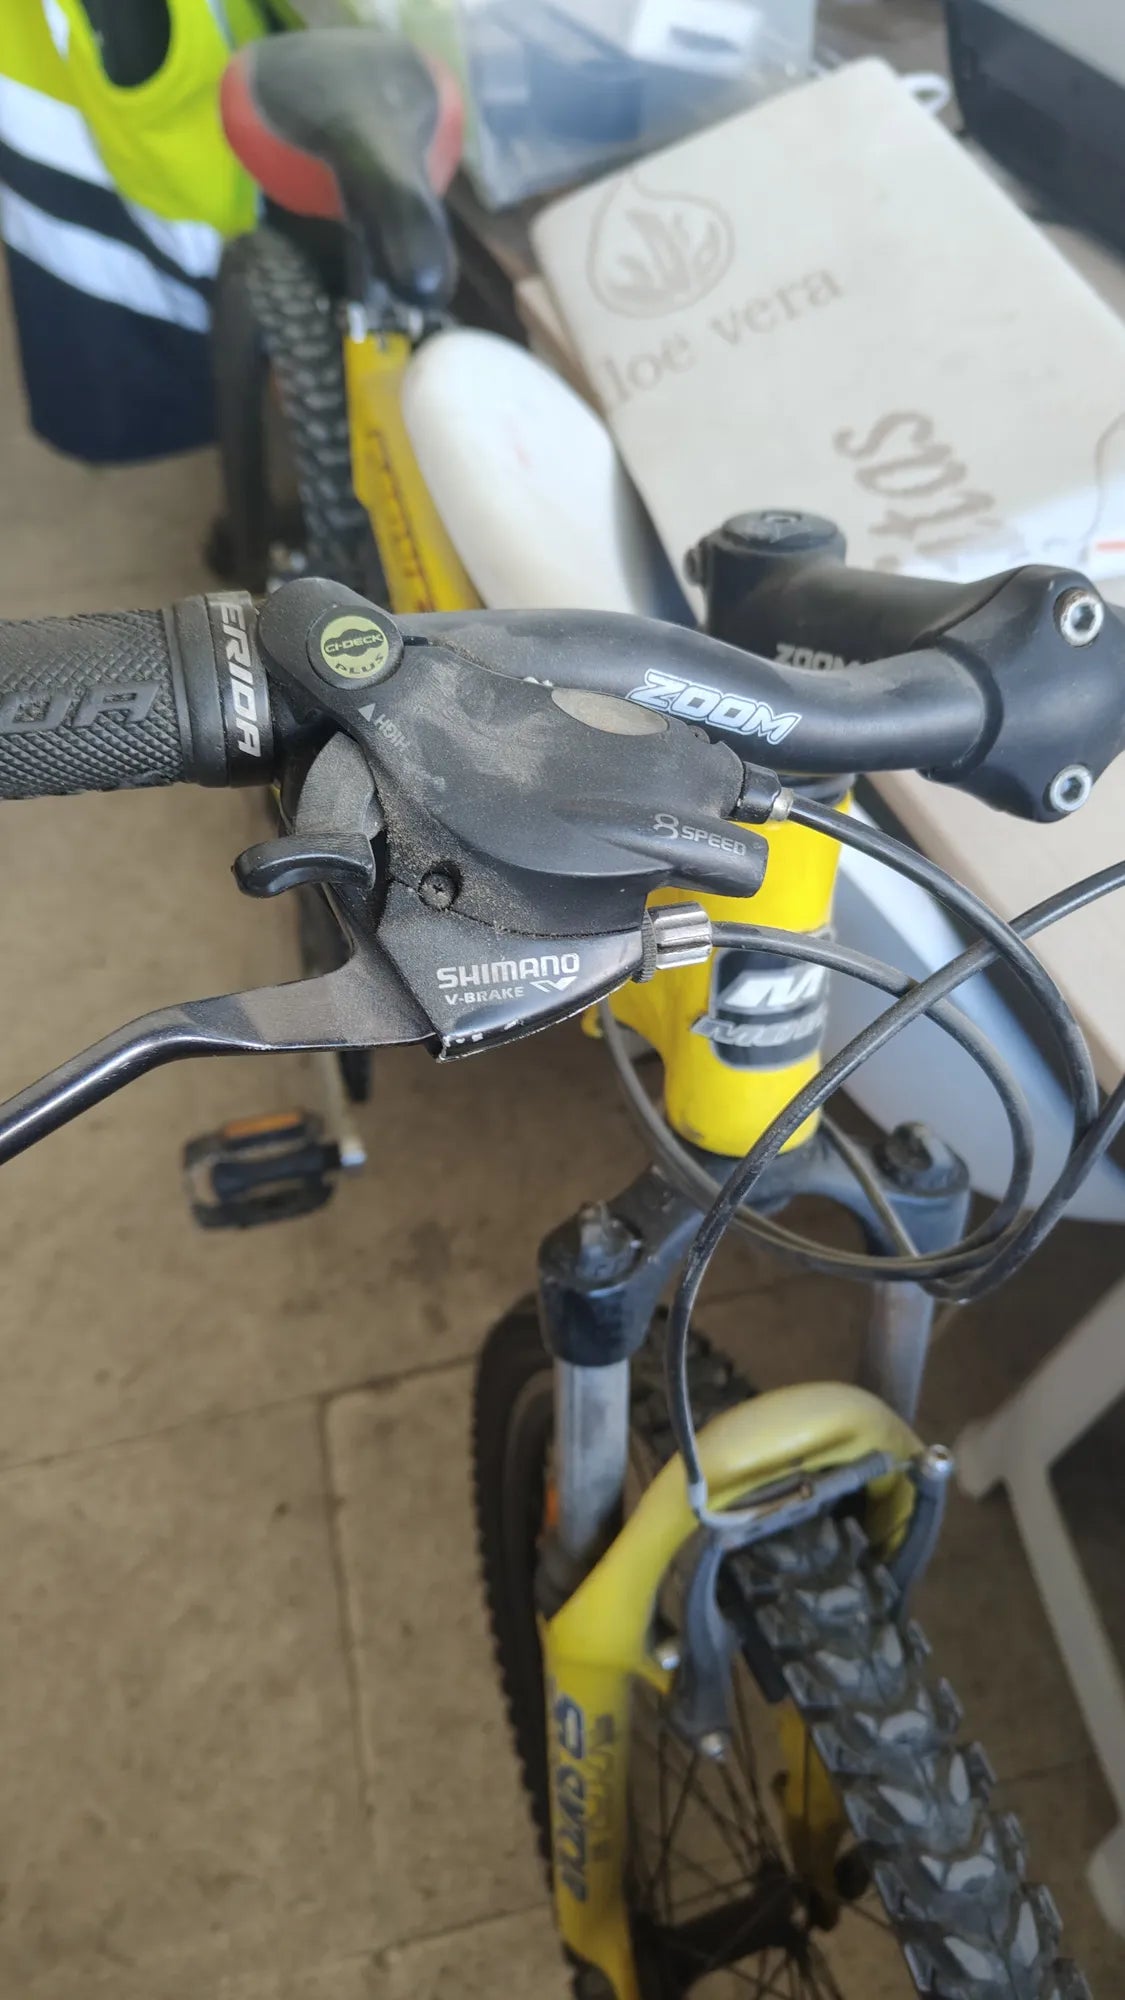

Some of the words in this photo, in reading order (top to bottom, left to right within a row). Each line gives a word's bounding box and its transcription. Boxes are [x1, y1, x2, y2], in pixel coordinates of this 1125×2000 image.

[602, 332, 698, 402] loe
[710, 268, 843, 346] vera
[221, 603, 262, 758] ERIDA
[335, 653, 384, 674] PLUS
[625, 668, 802, 745] ZOOM
[652, 812, 680, 839] 8
[680, 826, 747, 857] SPEED
[436, 952, 581, 989] SHIMANO
[444, 986, 525, 1006] V-BRAKE
